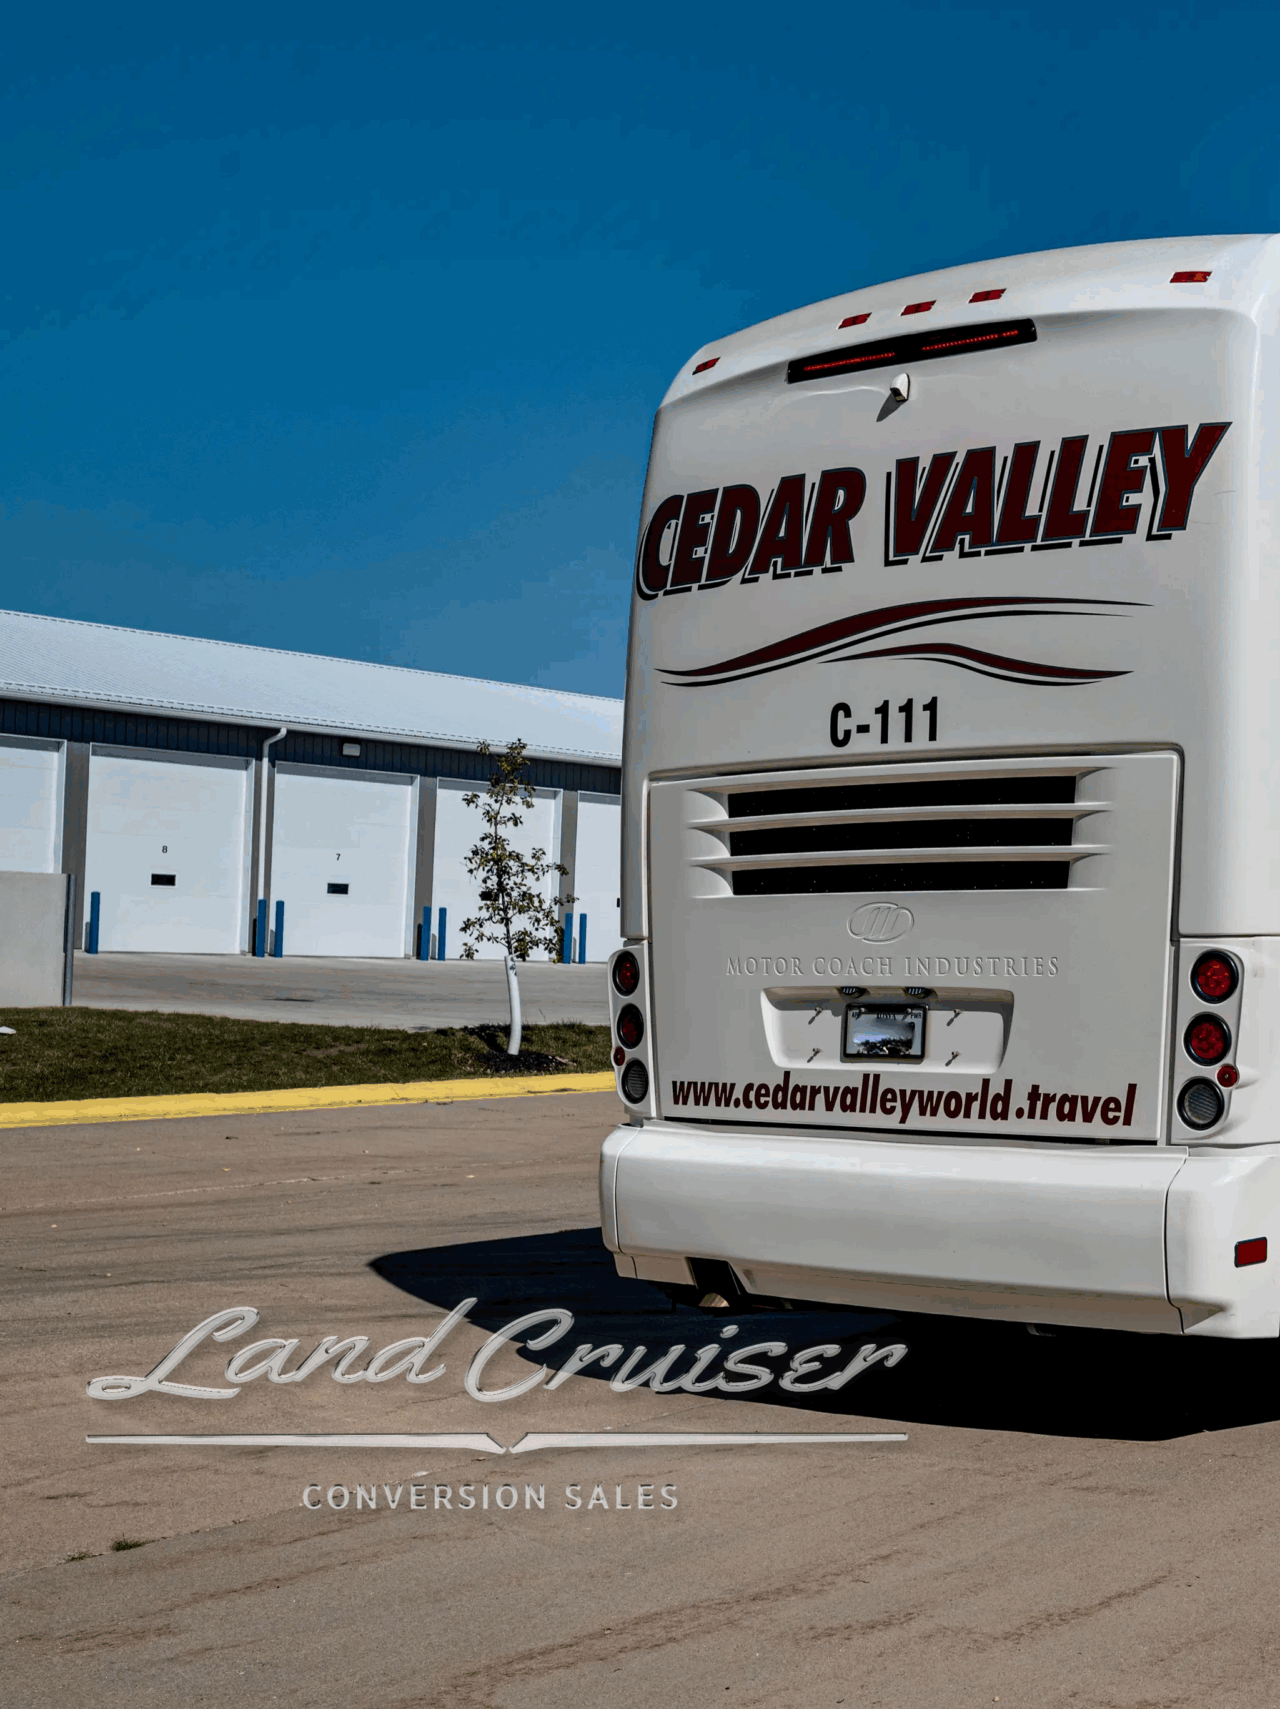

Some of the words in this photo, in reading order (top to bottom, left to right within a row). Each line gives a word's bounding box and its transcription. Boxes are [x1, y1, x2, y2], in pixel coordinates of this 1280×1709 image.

[636, 467, 867, 601] CEDAR
[884, 421, 1233, 567] VALLEY
[829, 696, 939, 748] C-111
[161, 845, 168, 854] 8
[335, 853, 342, 861] 7
[726, 956, 804, 977] MOTOR
[811, 956, 893, 977] COACH
[904, 956, 1060, 977] INDUSTRIES
